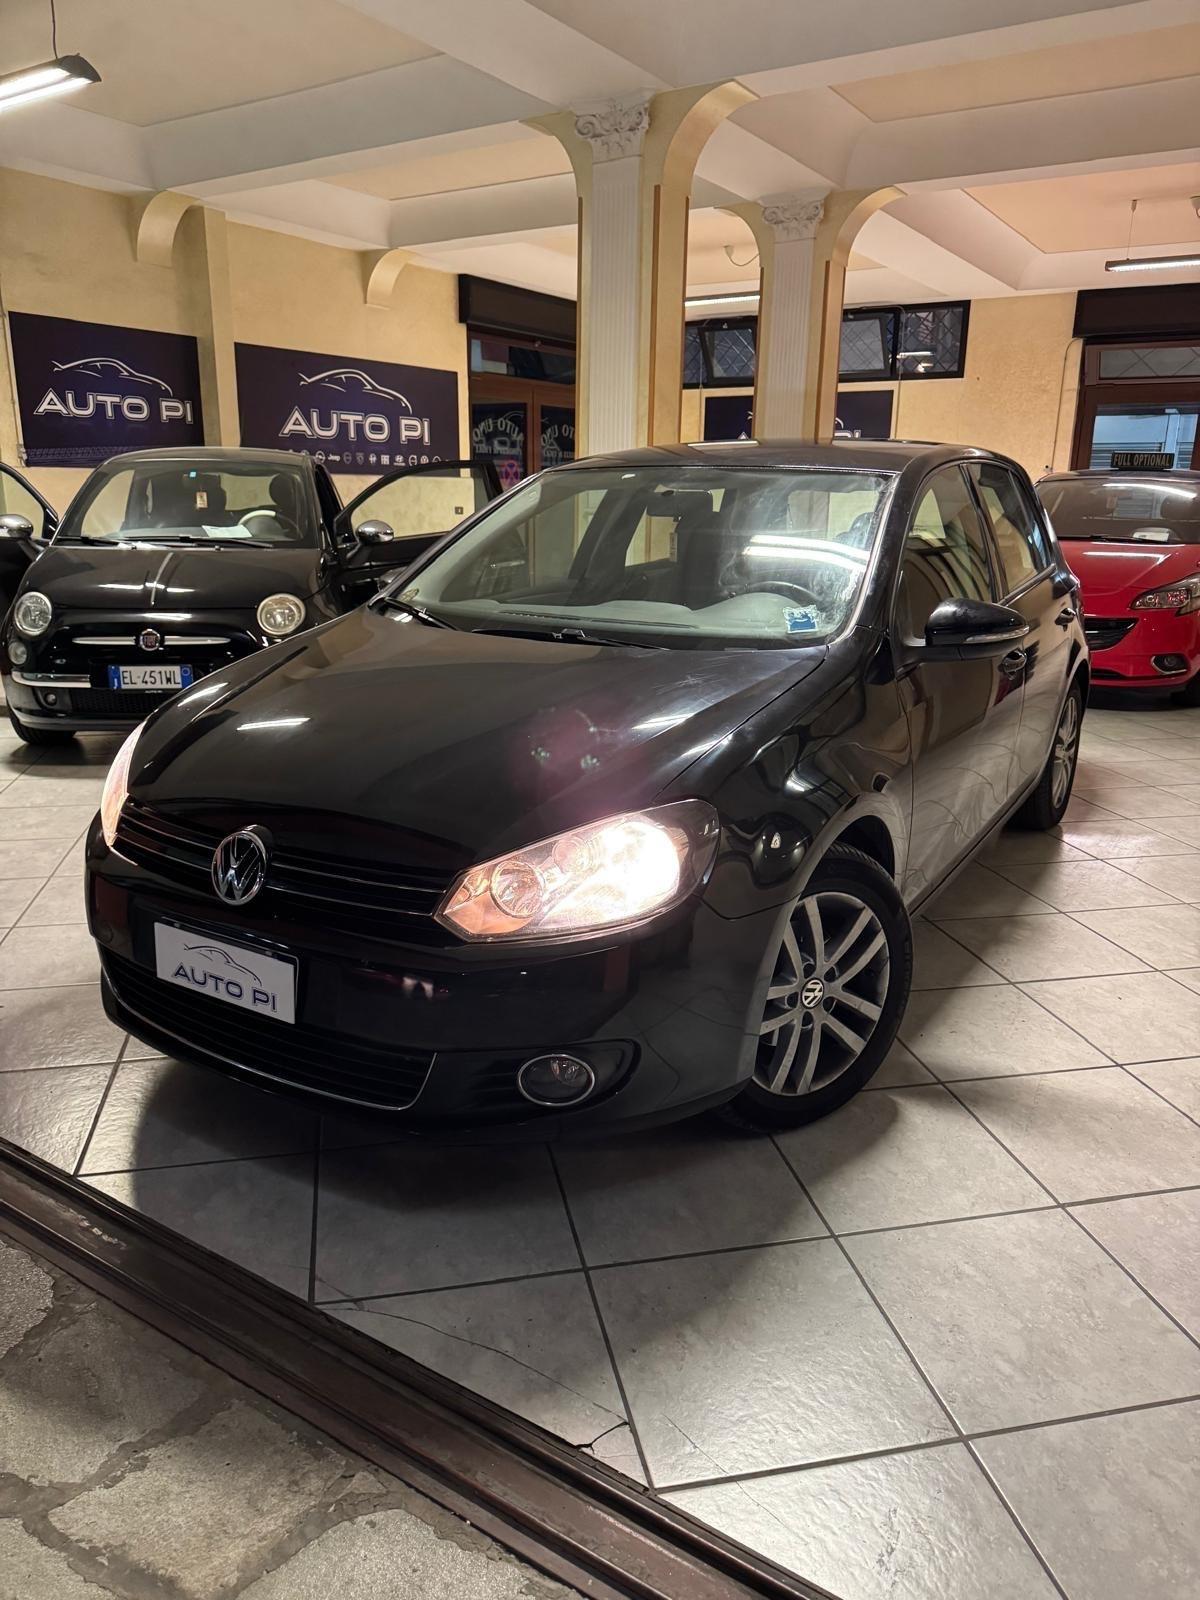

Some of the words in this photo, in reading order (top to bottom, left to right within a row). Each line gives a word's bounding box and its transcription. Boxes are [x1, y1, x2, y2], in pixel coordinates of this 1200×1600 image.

[33, 388, 150, 421] AUTO
[159, 397, 194, 424] PI
[278, 405, 390, 443] AUTO
[399, 416, 431, 446] PI
[1113, 453, 1131, 466] FULL
[1134, 453, 1170, 467] OPTIONAL
[172, 962, 244, 1000] AUTO
[251, 987, 278, 1012] PI
